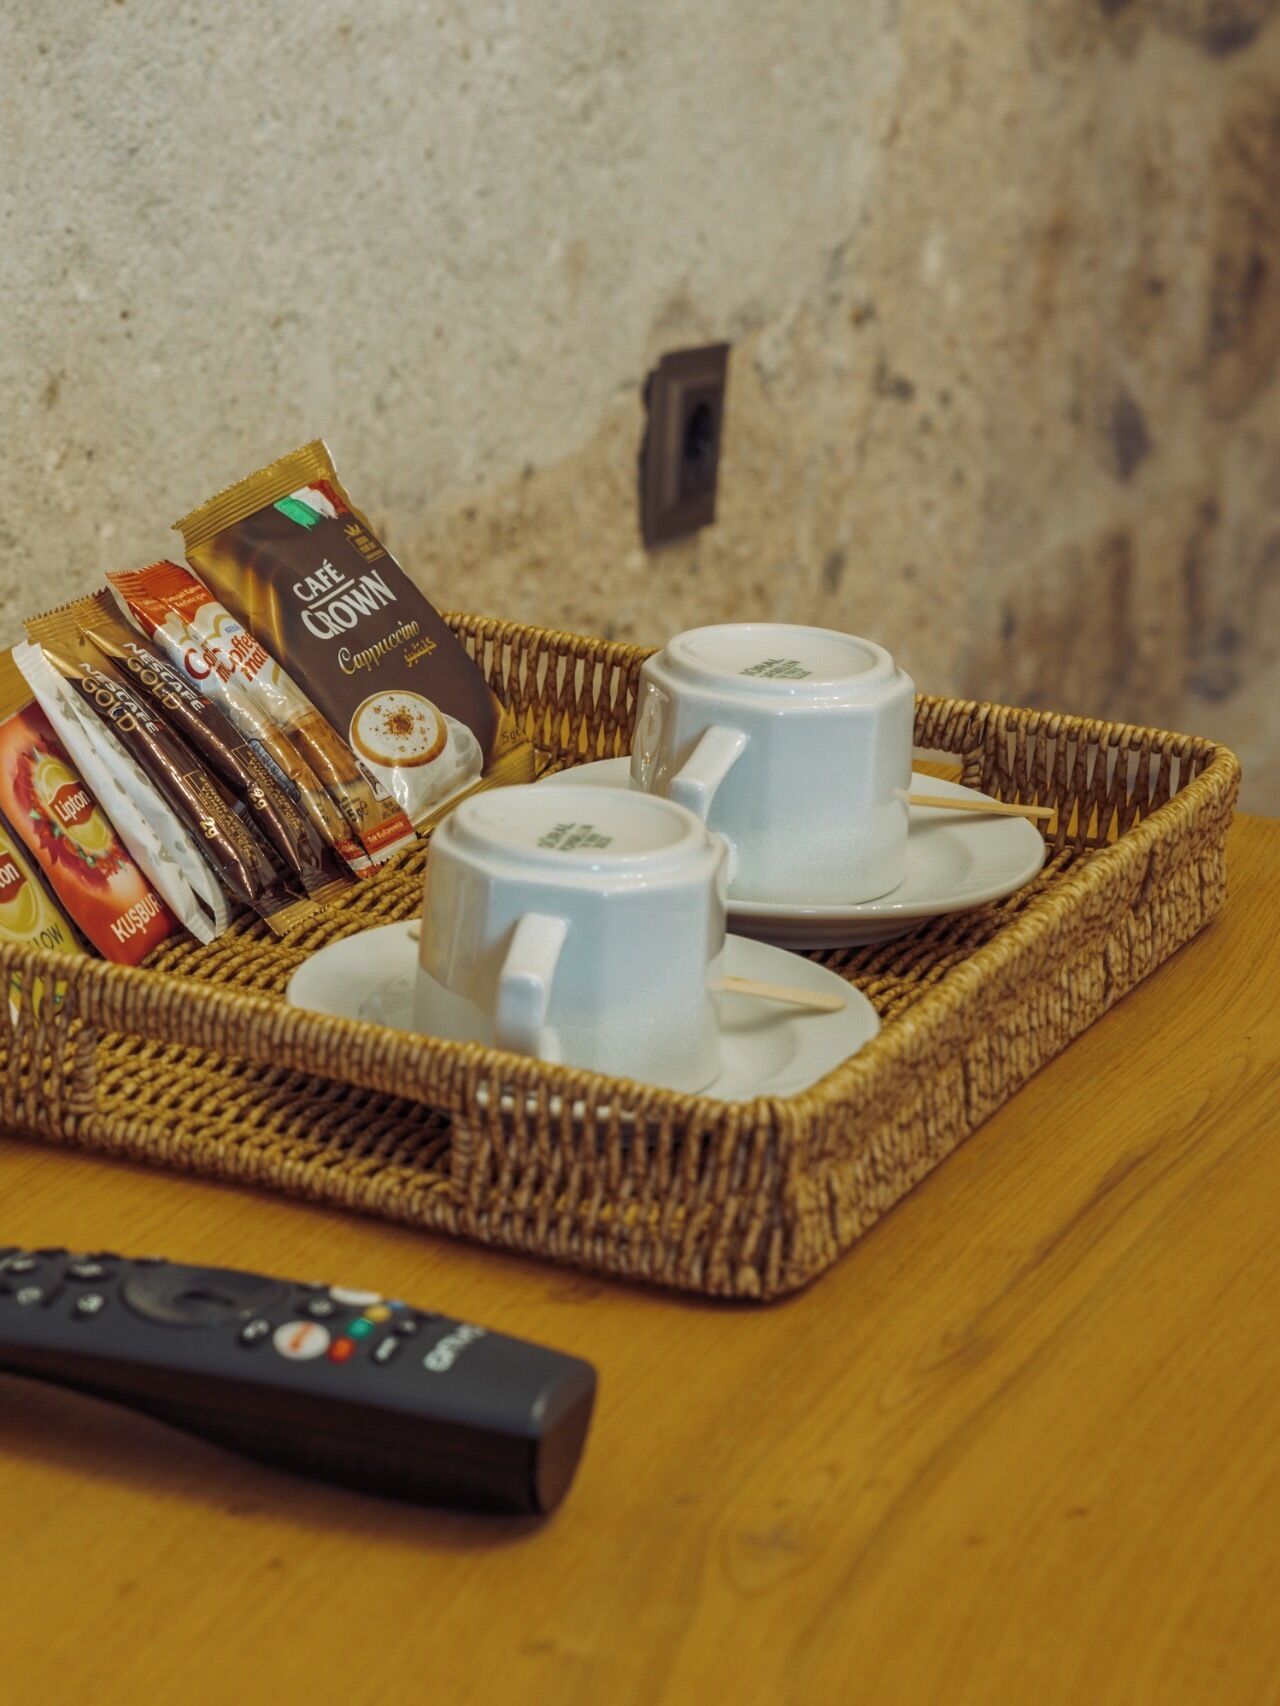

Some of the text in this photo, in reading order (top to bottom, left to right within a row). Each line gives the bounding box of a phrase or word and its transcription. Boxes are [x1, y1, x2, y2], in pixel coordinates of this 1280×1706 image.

[293, 559, 345, 601] CAFÉ
[301, 570, 397, 640] CROWN
[337, 620, 420, 675] Cappuccino
[81, 676, 137, 732] GOLD
[127, 656, 182, 710] GOLD
[54, 790, 91, 822] Lipton
[200, 816, 219, 838] 2g
